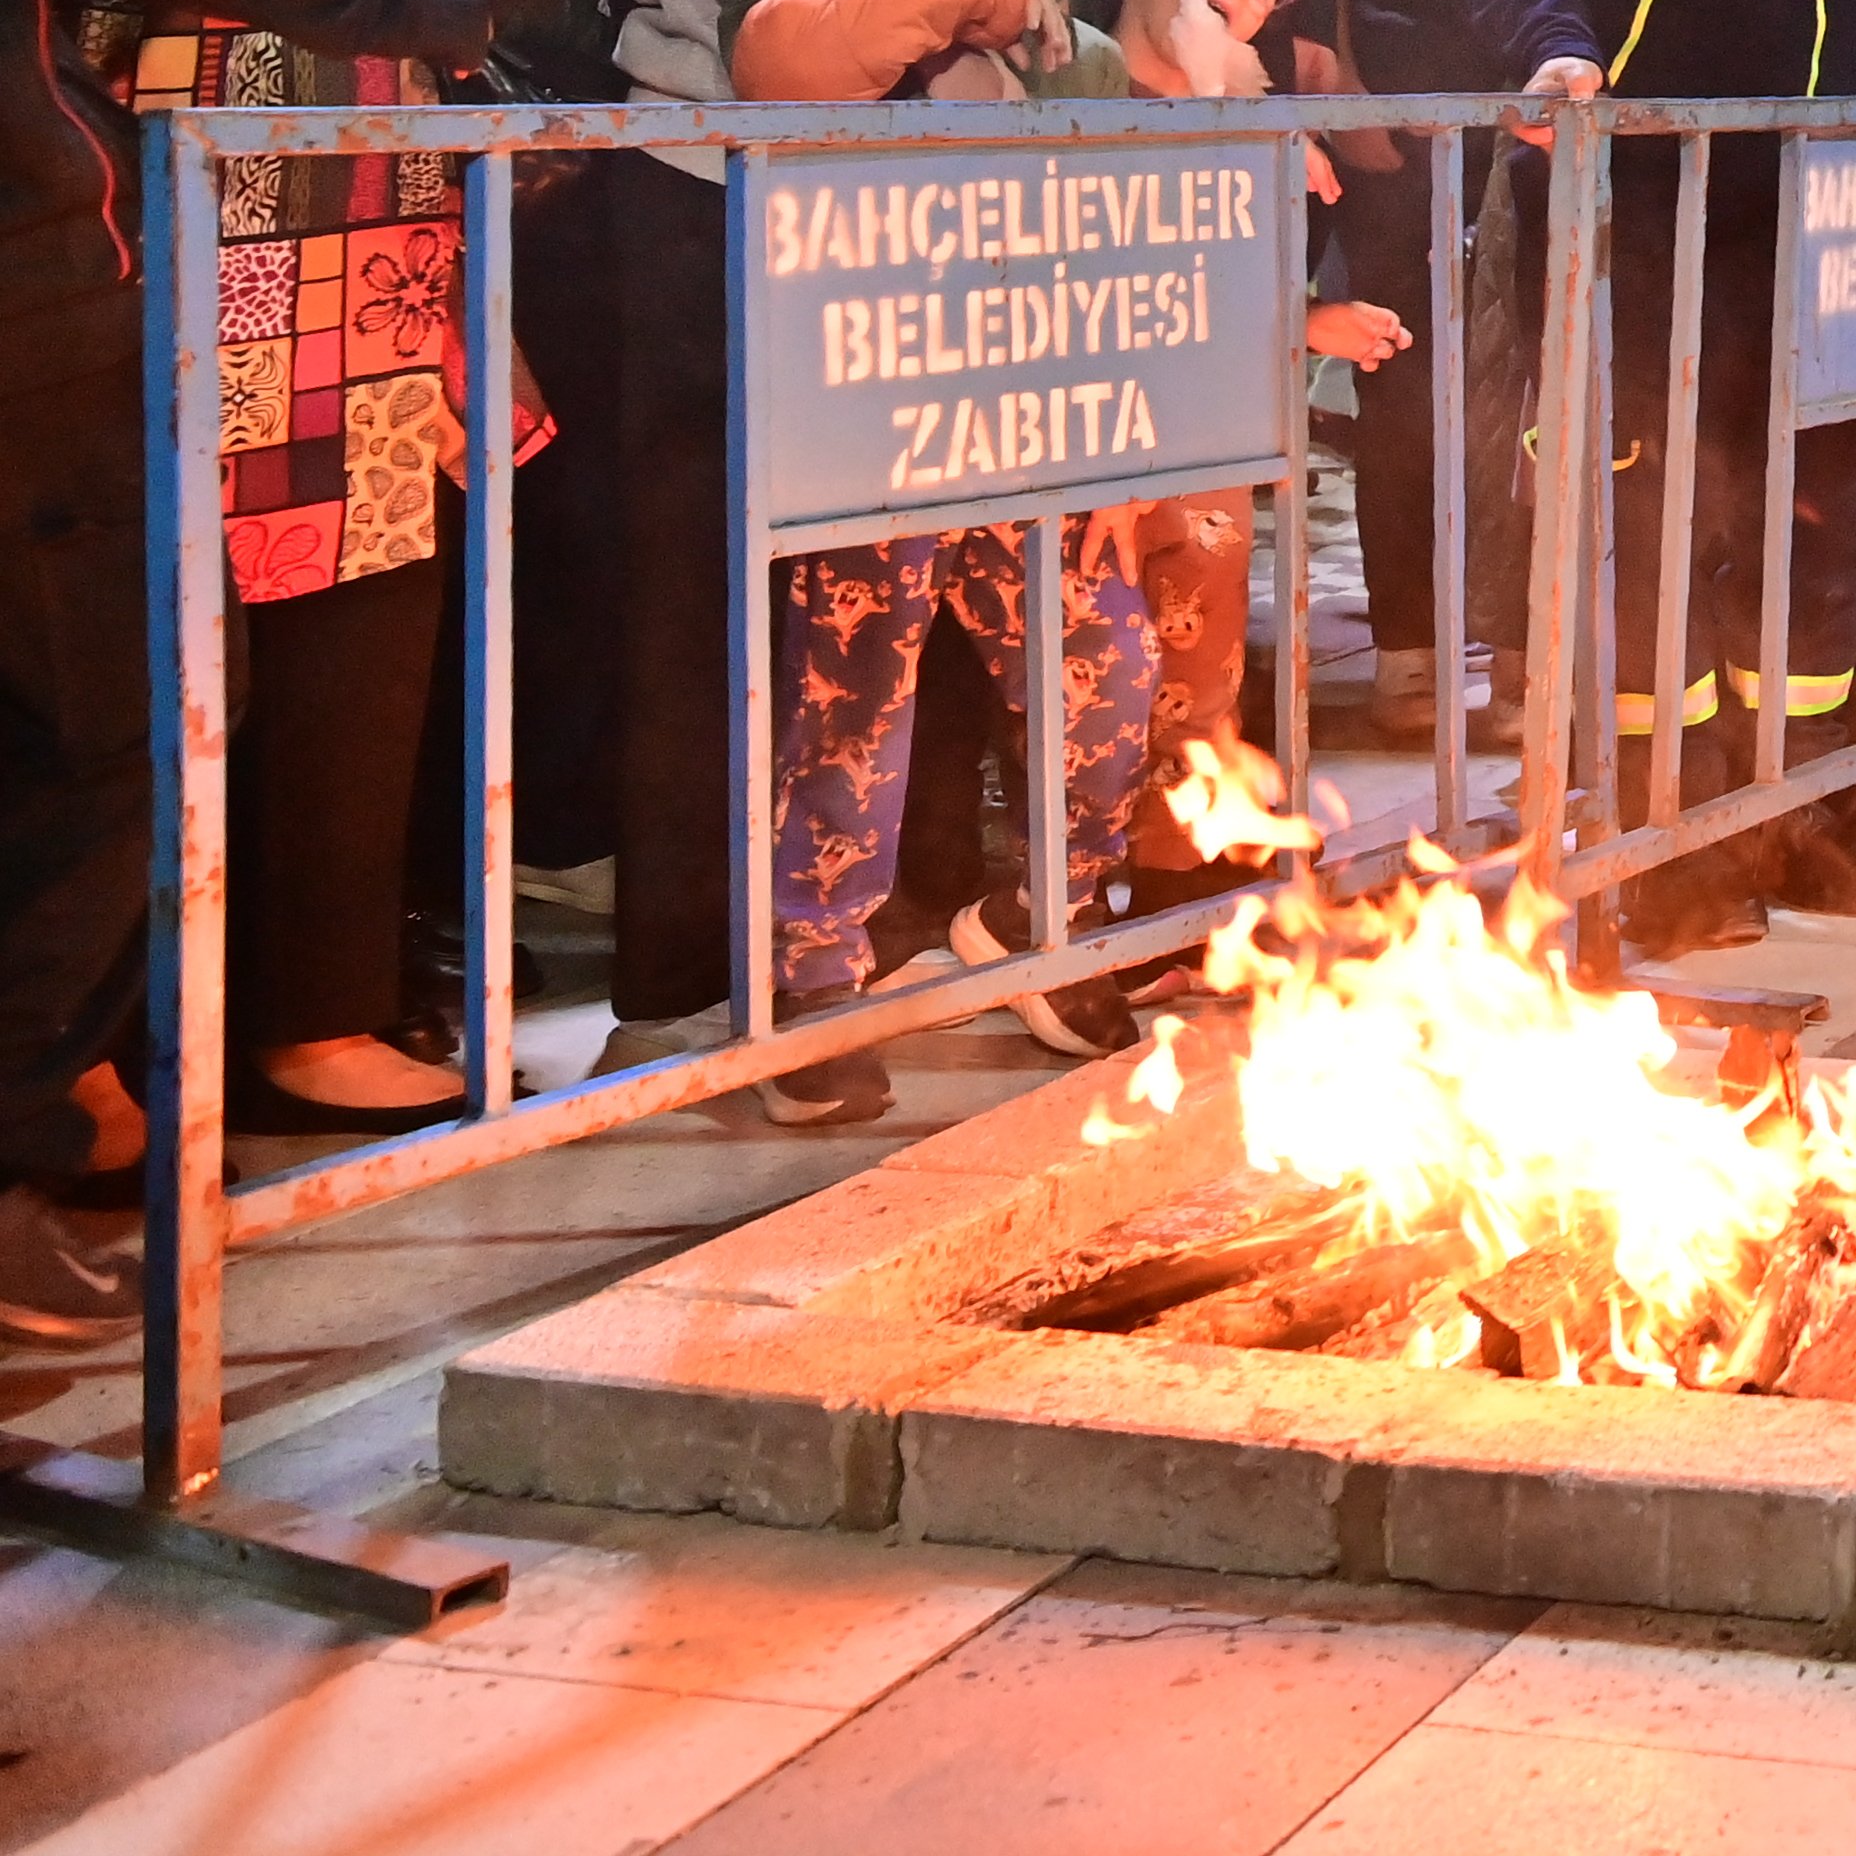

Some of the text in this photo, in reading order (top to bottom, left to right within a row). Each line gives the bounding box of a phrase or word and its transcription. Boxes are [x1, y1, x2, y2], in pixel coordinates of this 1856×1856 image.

[766, 159, 1257, 282] BAHÇELİEVLER
[823, 253, 1212, 387] BELEDİYESİ
[889, 379, 1158, 491] ZABITA
